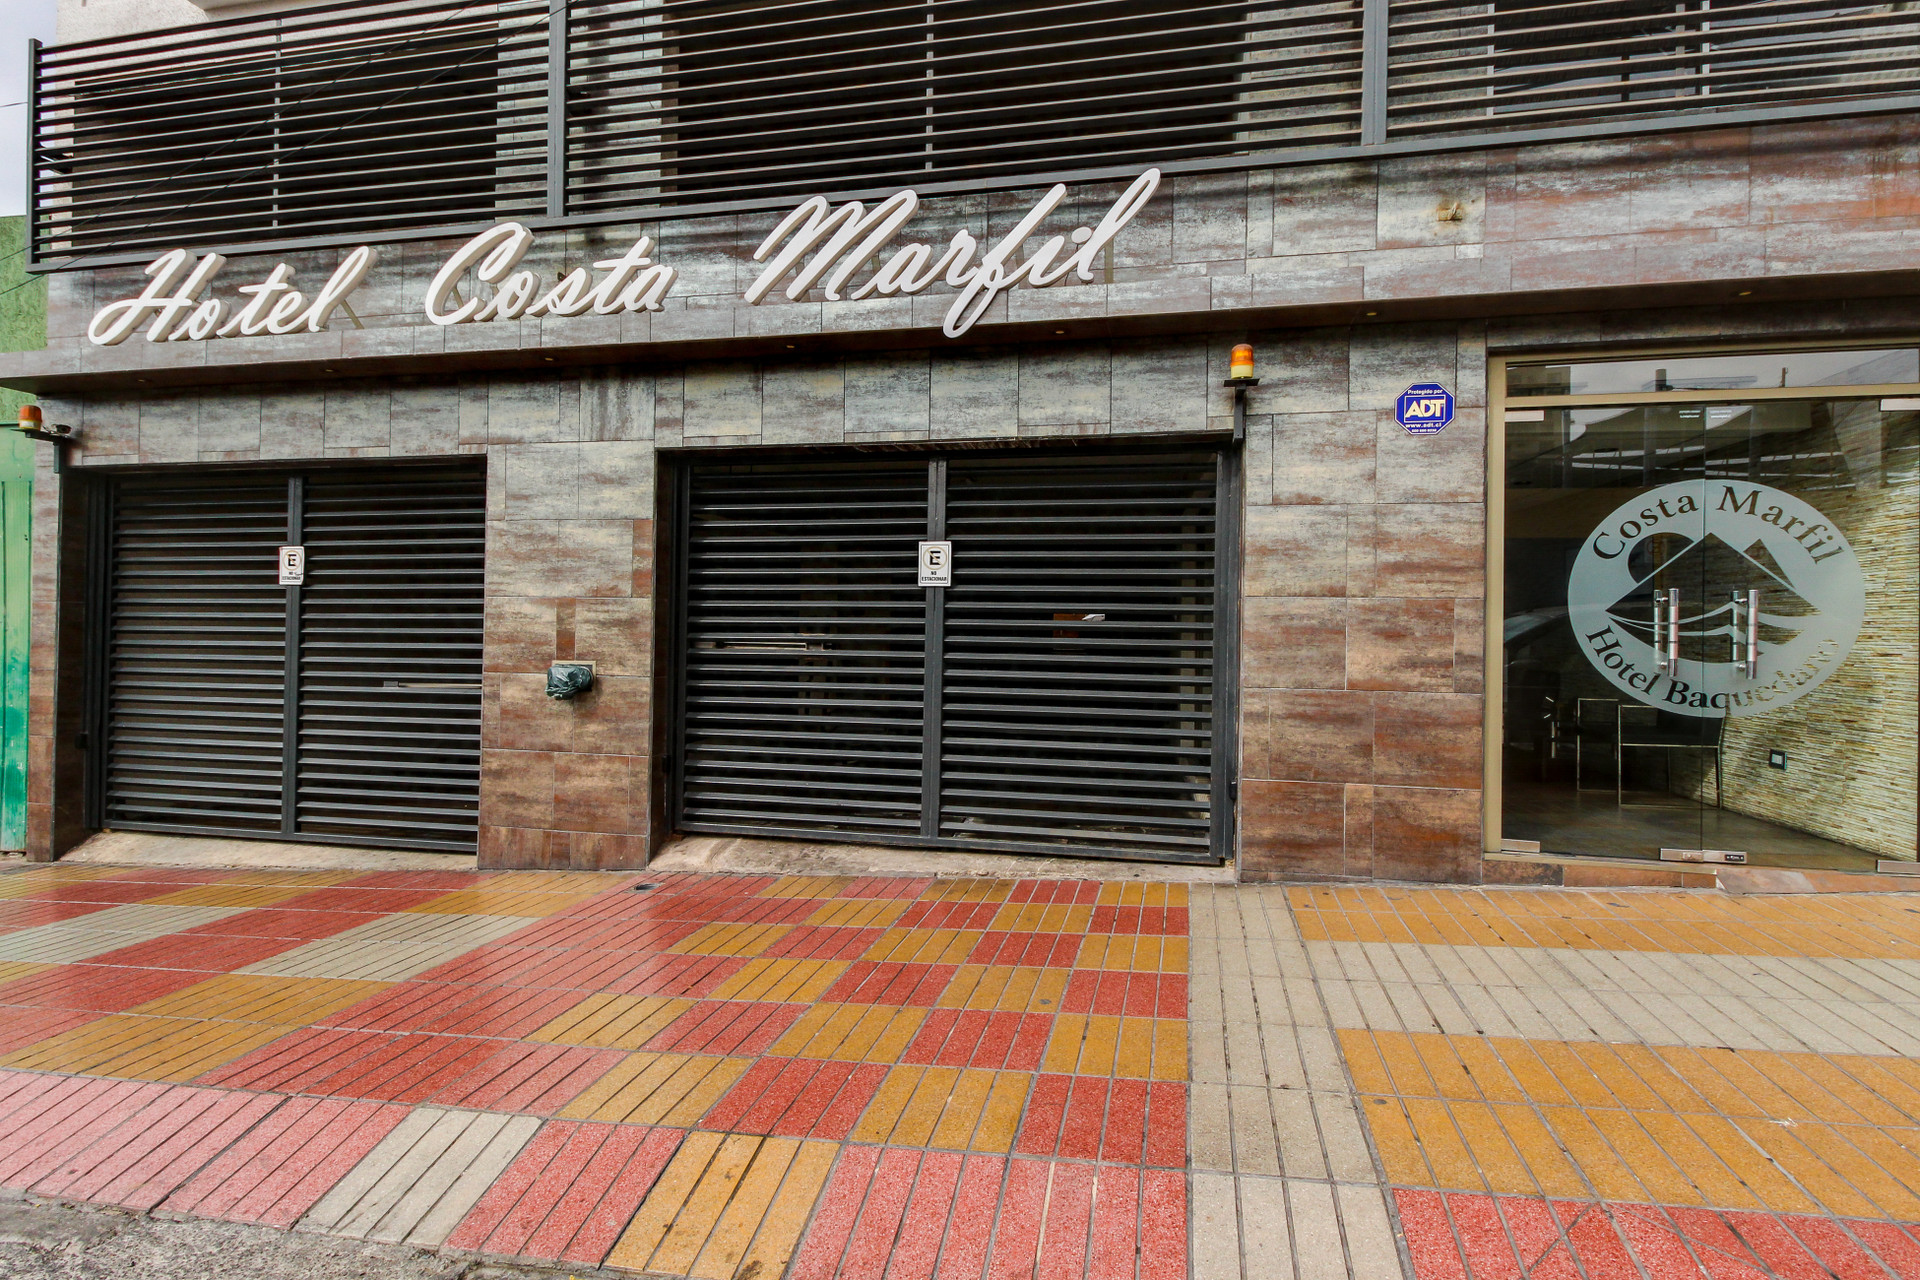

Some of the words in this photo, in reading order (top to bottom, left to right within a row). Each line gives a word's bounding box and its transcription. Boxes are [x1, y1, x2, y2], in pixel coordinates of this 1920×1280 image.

[88, 248, 378, 346] Hotel
[424, 221, 678, 326] Costa
[743, 167, 1162, 339] Marfil
[1405, 400, 1445, 418] ADT
[1593, 494, 1699, 561] Costa
[1716, 485, 1844, 565] Marfil
[1585, 626, 1661, 696] Hotel
